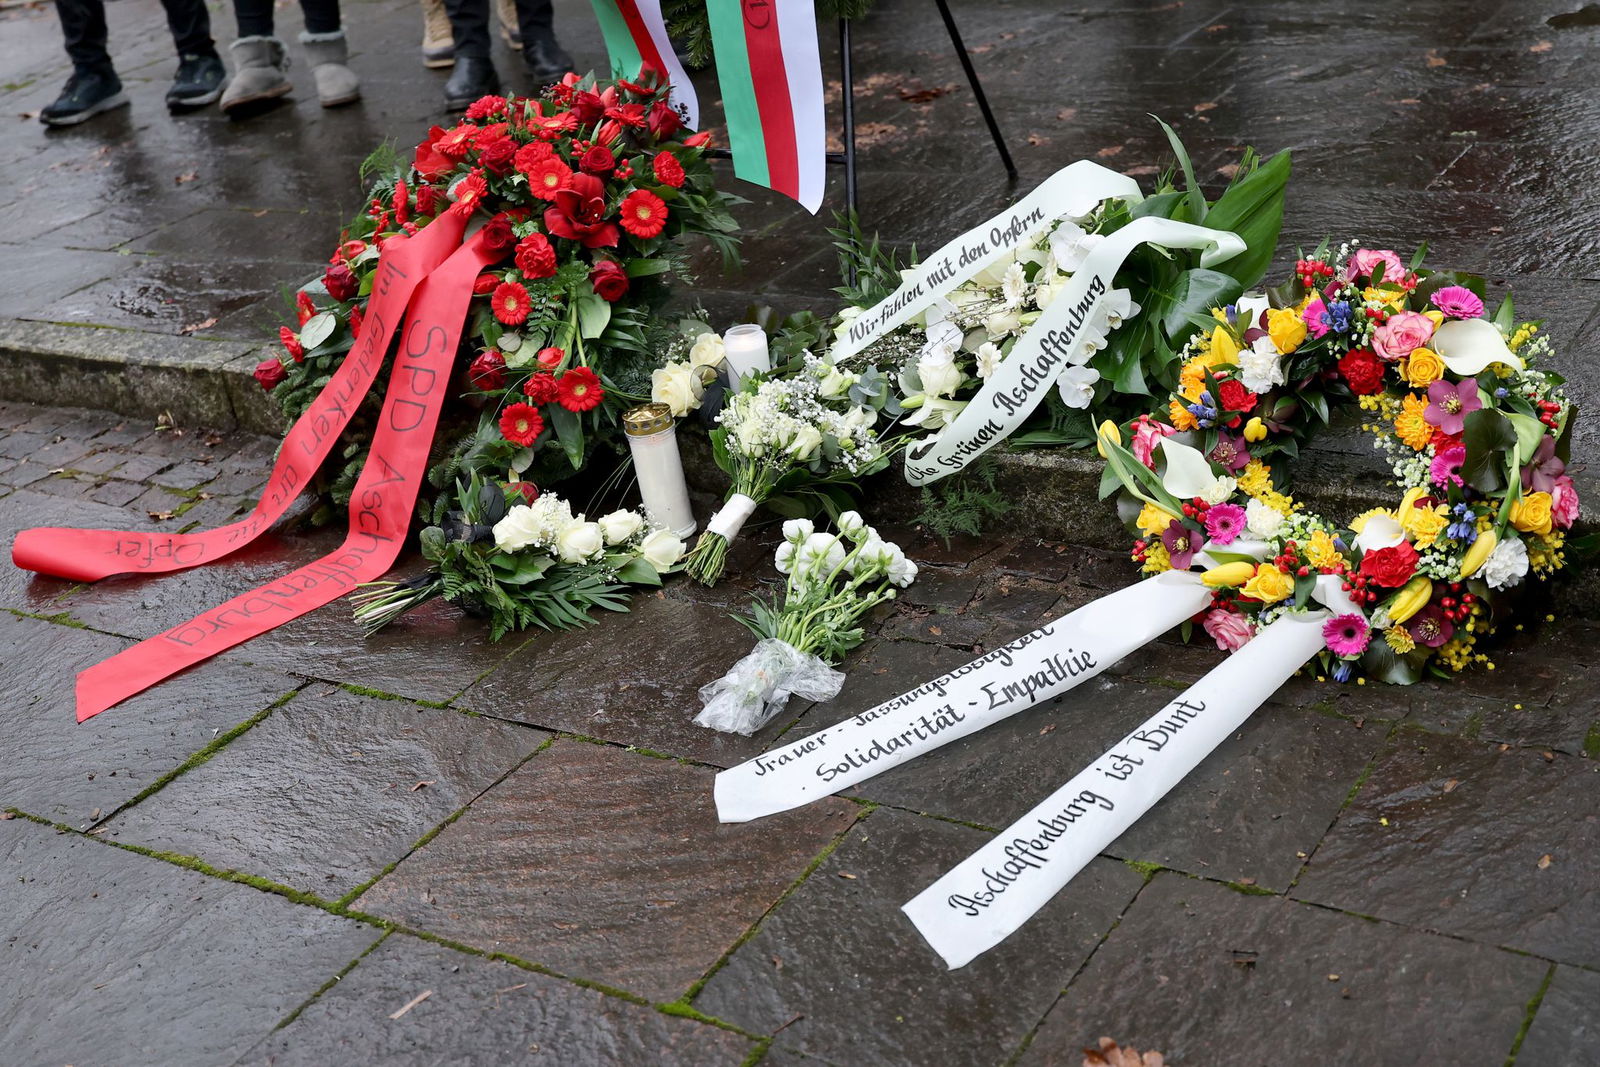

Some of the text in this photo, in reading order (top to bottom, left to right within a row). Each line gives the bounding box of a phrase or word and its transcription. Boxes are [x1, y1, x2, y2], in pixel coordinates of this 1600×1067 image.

[379, 261, 408, 296] Im
[848, 206, 1046, 345] Wir fühlen mit den Opfern
[300, 311, 386, 456] Gedenken
[936, 418, 1004, 469] Grünen
[991, 272, 1105, 417] Aschaffenburg
[164, 318, 448, 647] SPD Aschaffenburg
[104, 538, 205, 569] Opfer
[749, 732, 829, 777] Trauer
[815, 703, 966, 783] Solidarität
[980, 647, 1098, 712] Empathie
[948, 697, 1207, 917] Aschaffenburg ist Bunt
